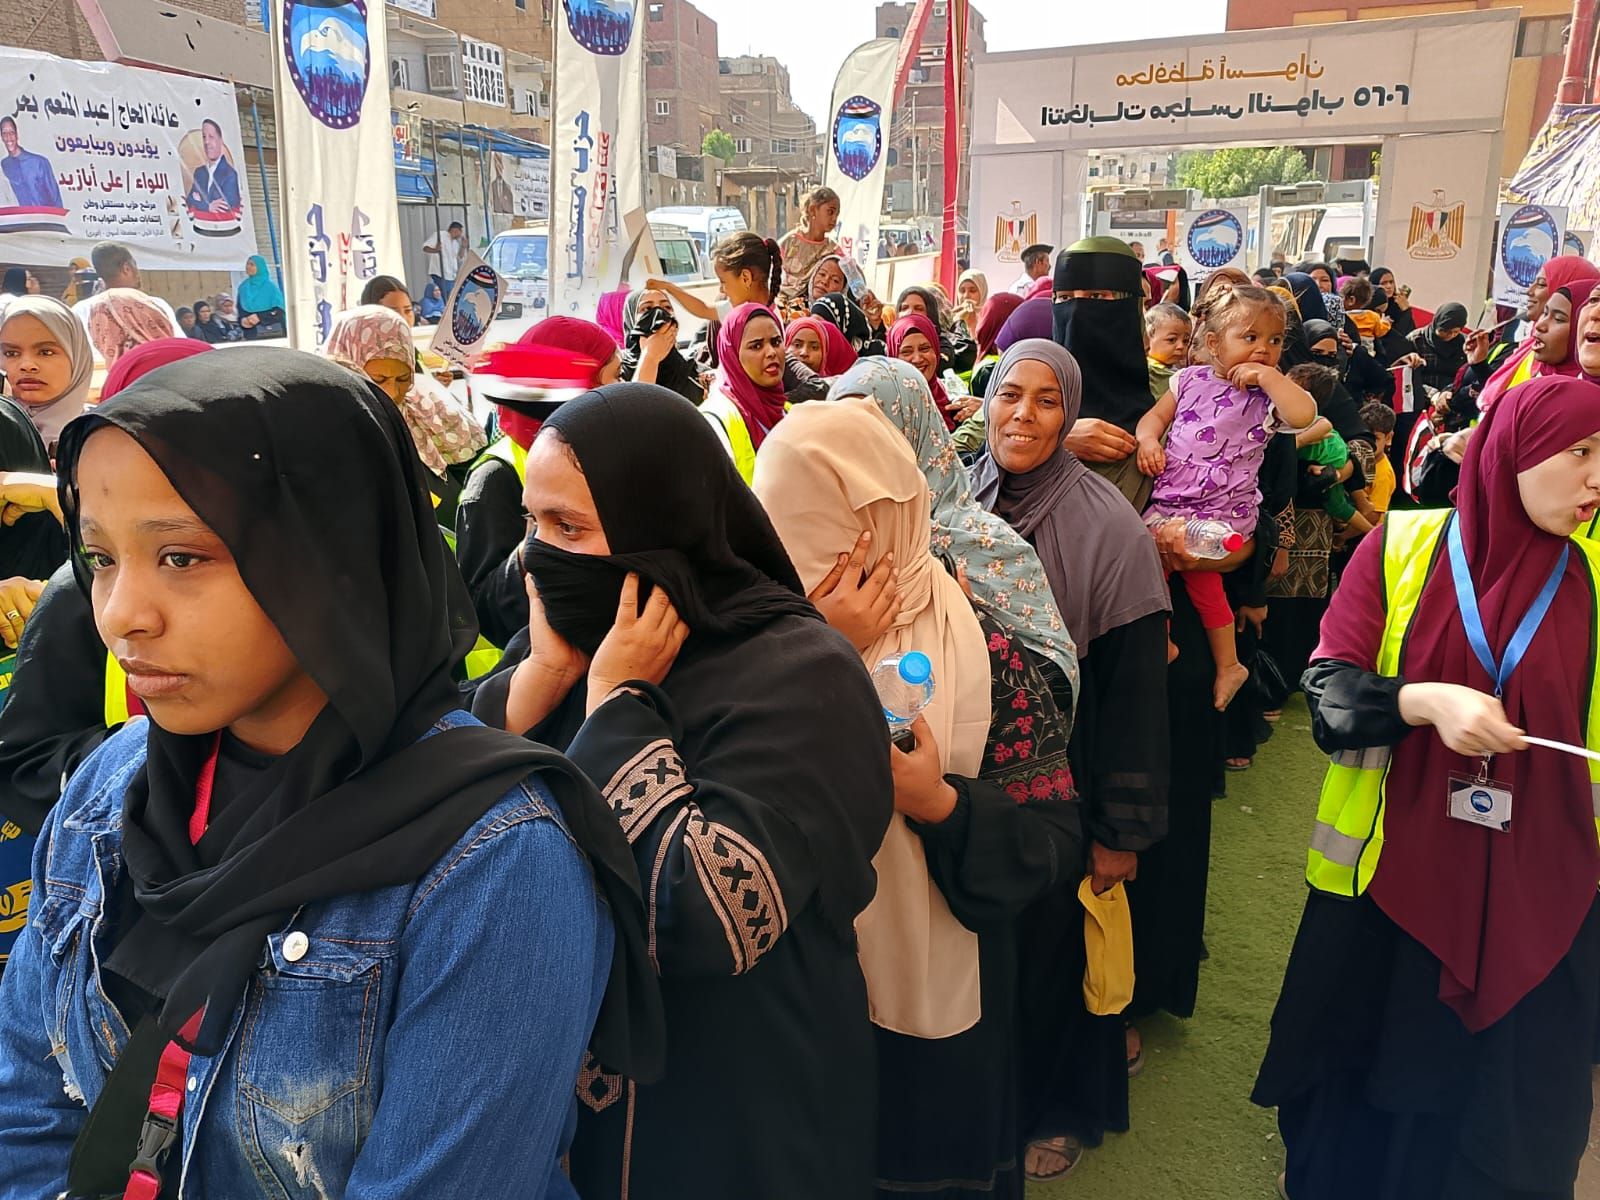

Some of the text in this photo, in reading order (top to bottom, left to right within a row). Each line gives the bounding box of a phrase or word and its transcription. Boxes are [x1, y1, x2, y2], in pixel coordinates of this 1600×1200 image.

[44, 90, 79, 121] المنعم
[83, 98, 110, 126] عبد
[118, 101, 149, 130] الحاج
[148, 102, 179, 128] عائلة
[55, 133, 160, 159] يؤيدون ويبايعون
[58, 163, 98, 192] أبازيد
[135, 171, 170, 194] اللواء
[307, 203, 332, 283] حزب
